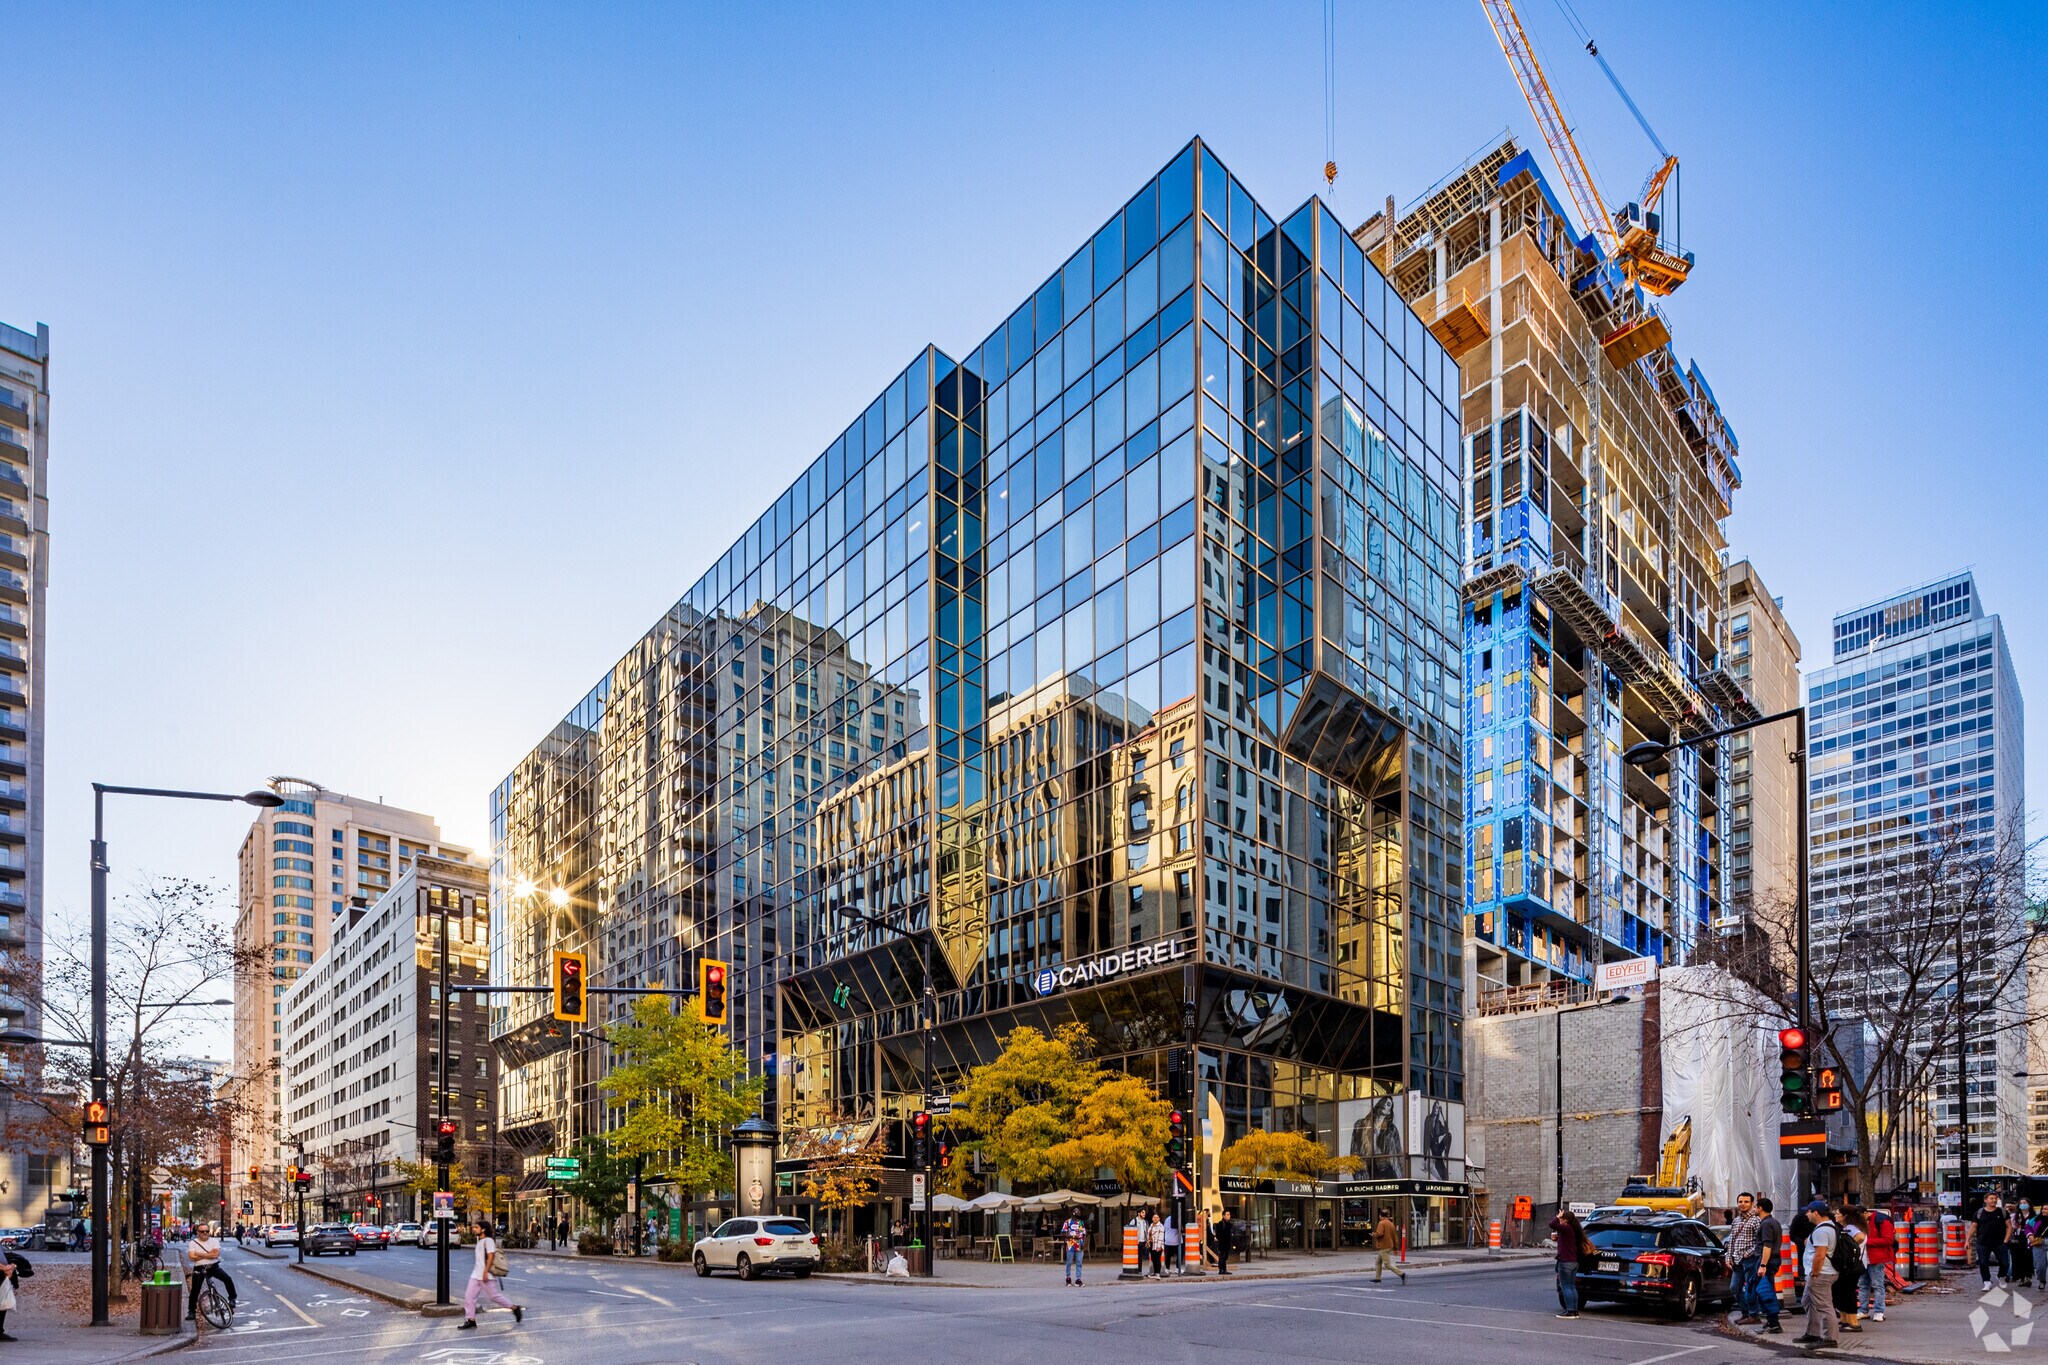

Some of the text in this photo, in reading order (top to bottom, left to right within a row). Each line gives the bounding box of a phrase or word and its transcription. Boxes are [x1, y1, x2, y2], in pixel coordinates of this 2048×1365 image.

[1059, 939, 1185, 986] CANDEREL
[1609, 963, 1643, 977] EDYFIC
[1606, 976, 1647, 987] CONSTRUCTION
[1094, 1183, 1121, 1191] MANGIA
[1291, 1183, 1299, 1192] Le
[1375, 1184, 1400, 1192] BARBER
